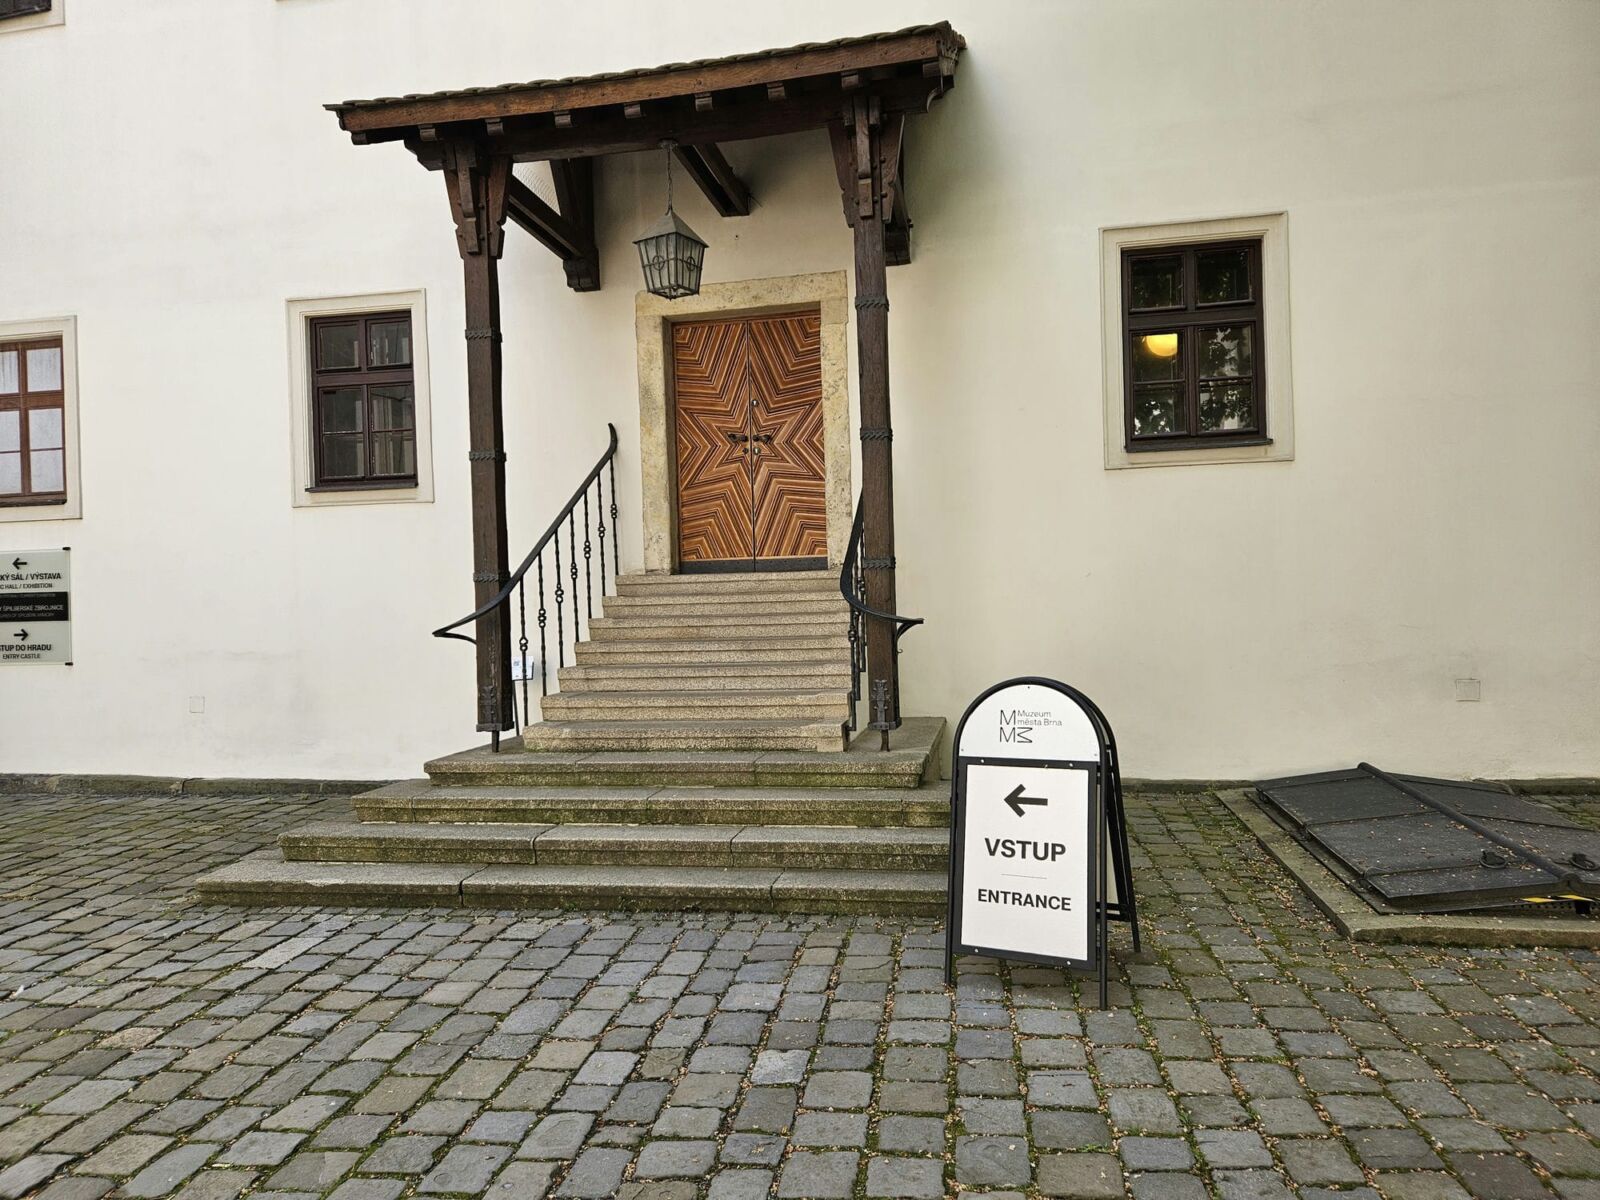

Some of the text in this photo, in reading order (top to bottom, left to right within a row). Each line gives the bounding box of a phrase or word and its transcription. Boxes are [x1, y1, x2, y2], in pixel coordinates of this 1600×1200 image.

[0, 572, 9, 581] KÝ
[11, 572, 24, 581] SÁL
[30, 572, 61, 580] VÝSTAVA
[1017, 710, 1052, 718] Muzeum
[1017, 718, 1063, 726] města Brna
[984, 837, 1067, 862] VSTUP
[977, 888, 1072, 912] ENTRANCE
